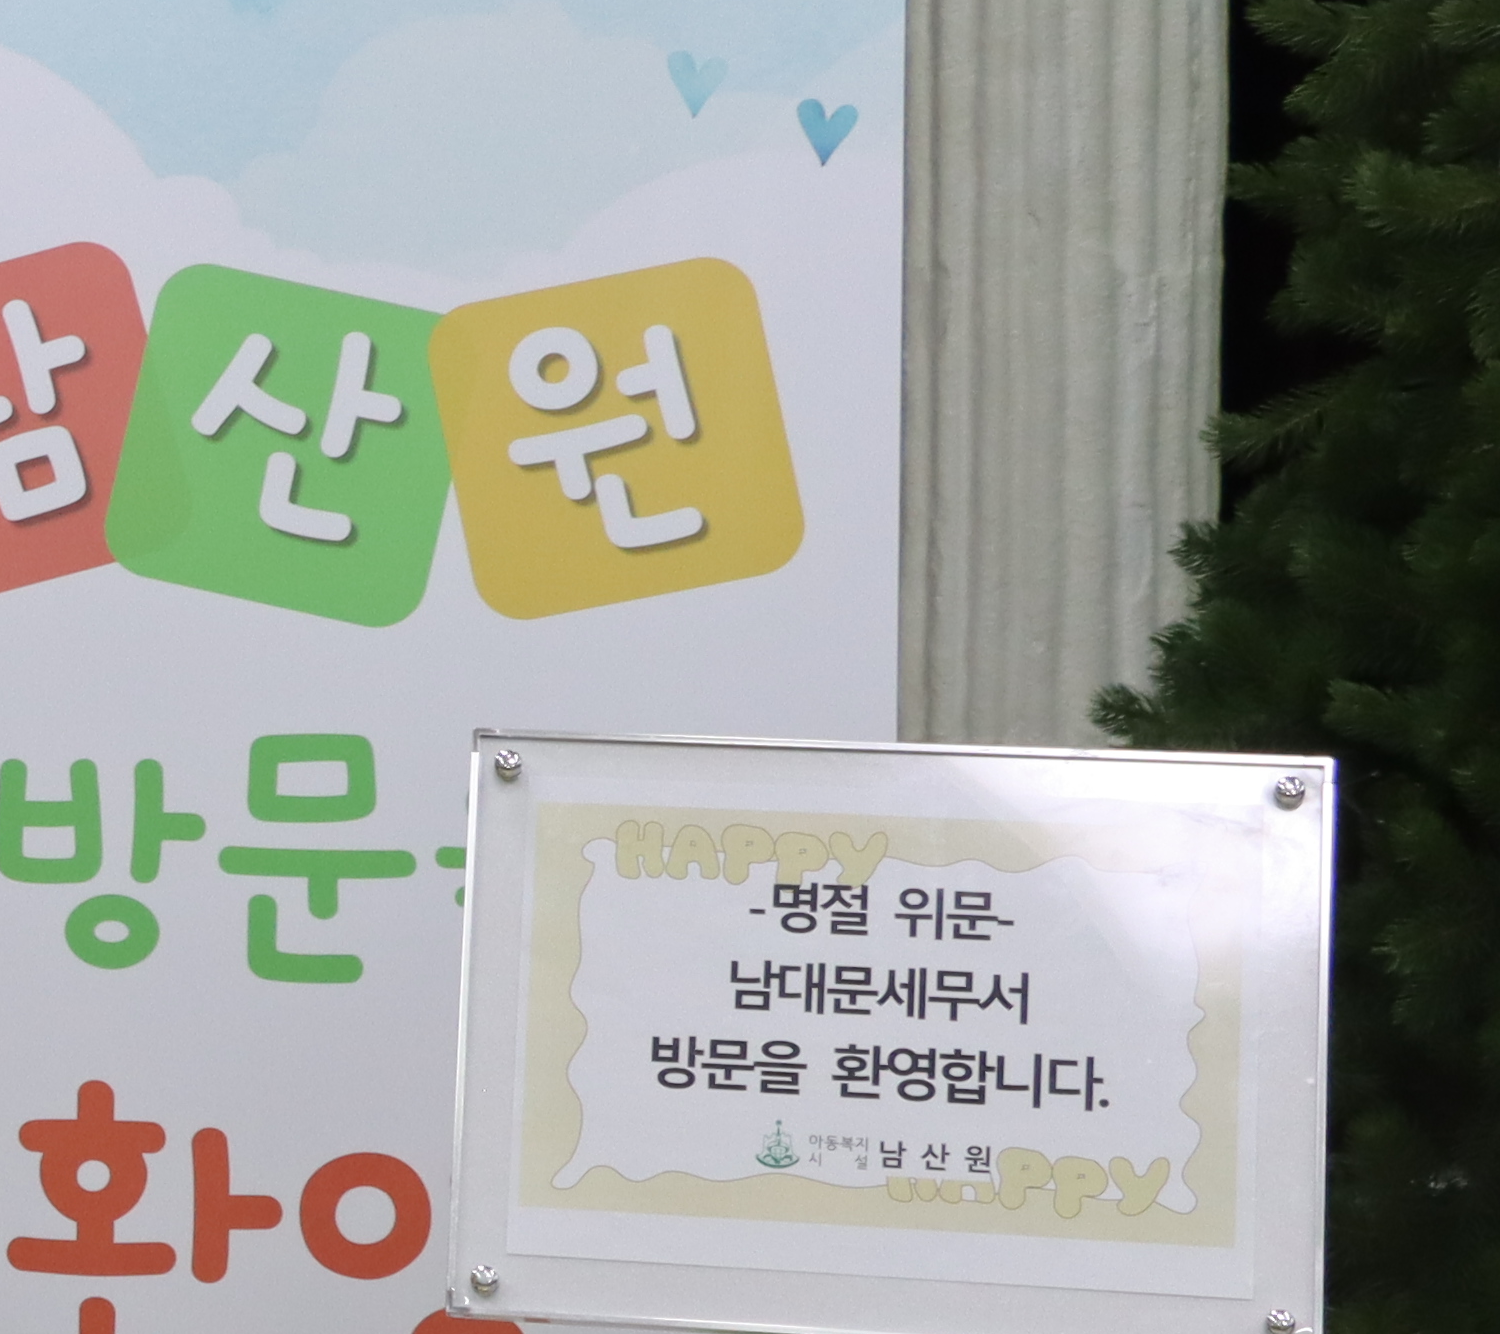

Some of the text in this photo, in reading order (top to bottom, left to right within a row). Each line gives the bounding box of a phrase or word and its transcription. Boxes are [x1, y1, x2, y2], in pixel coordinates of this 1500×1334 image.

[615, 820, 889, 893] HAPPY
[729, 959, 1030, 1026] 남대문세무서
[651, 1035, 1111, 1112] 방문을 환영합니다.
[808, 1134, 869, 1153] 아동복지
